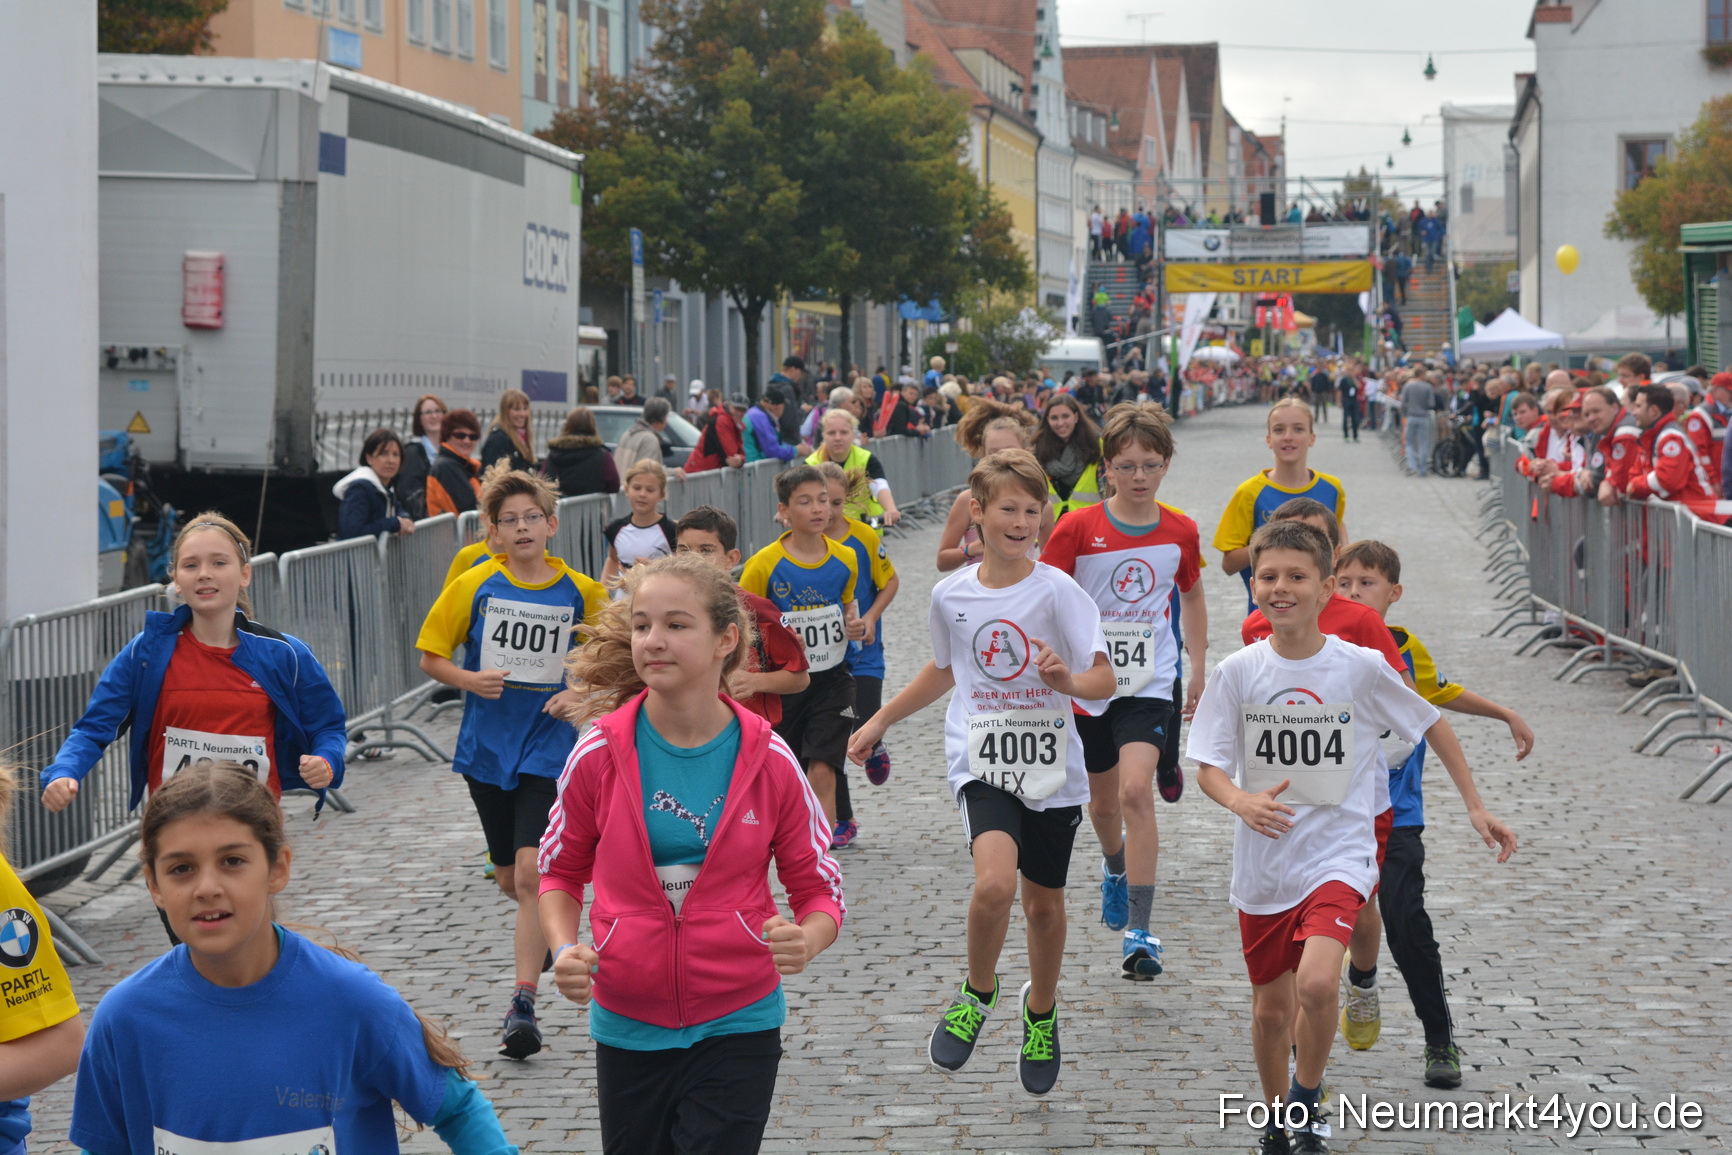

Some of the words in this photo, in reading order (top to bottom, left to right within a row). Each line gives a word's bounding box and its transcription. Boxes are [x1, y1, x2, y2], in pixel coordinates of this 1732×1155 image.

[523, 221, 570, 294] BOCK
[1233, 267, 1305, 286] START
[488, 605, 517, 617] PARTL
[518, 610, 559, 622] Neumarkt
[788, 615, 806, 625] ARTL
[807, 611, 836, 622] Neumarkt
[1141, 608, 1158, 617] HER
[491, 620, 560, 654] 4001
[1102, 629, 1140, 638] Neumarkt
[494, 653, 545, 668] JUSTUS
[809, 652, 829, 663] Paul
[1001, 691, 1021, 700] MIT
[1025, 687, 1053, 699] HERZ
[1007, 703, 1019, 711] Dr.
[970, 719, 1003, 731] PARTL
[1004, 718, 1051, 728] Neumarkt
[1245, 713, 1280, 724] PARTL
[1282, 714, 1335, 724] Neumarkt
[167, 736, 201, 751] PARTL
[202, 742, 253, 755] Neumarkt
[978, 731, 1057, 766] 4003
[1255, 728, 1346, 767] 4004
[0, 967, 50, 997] PARTL
[5, 981, 53, 1008] Neumarkt
